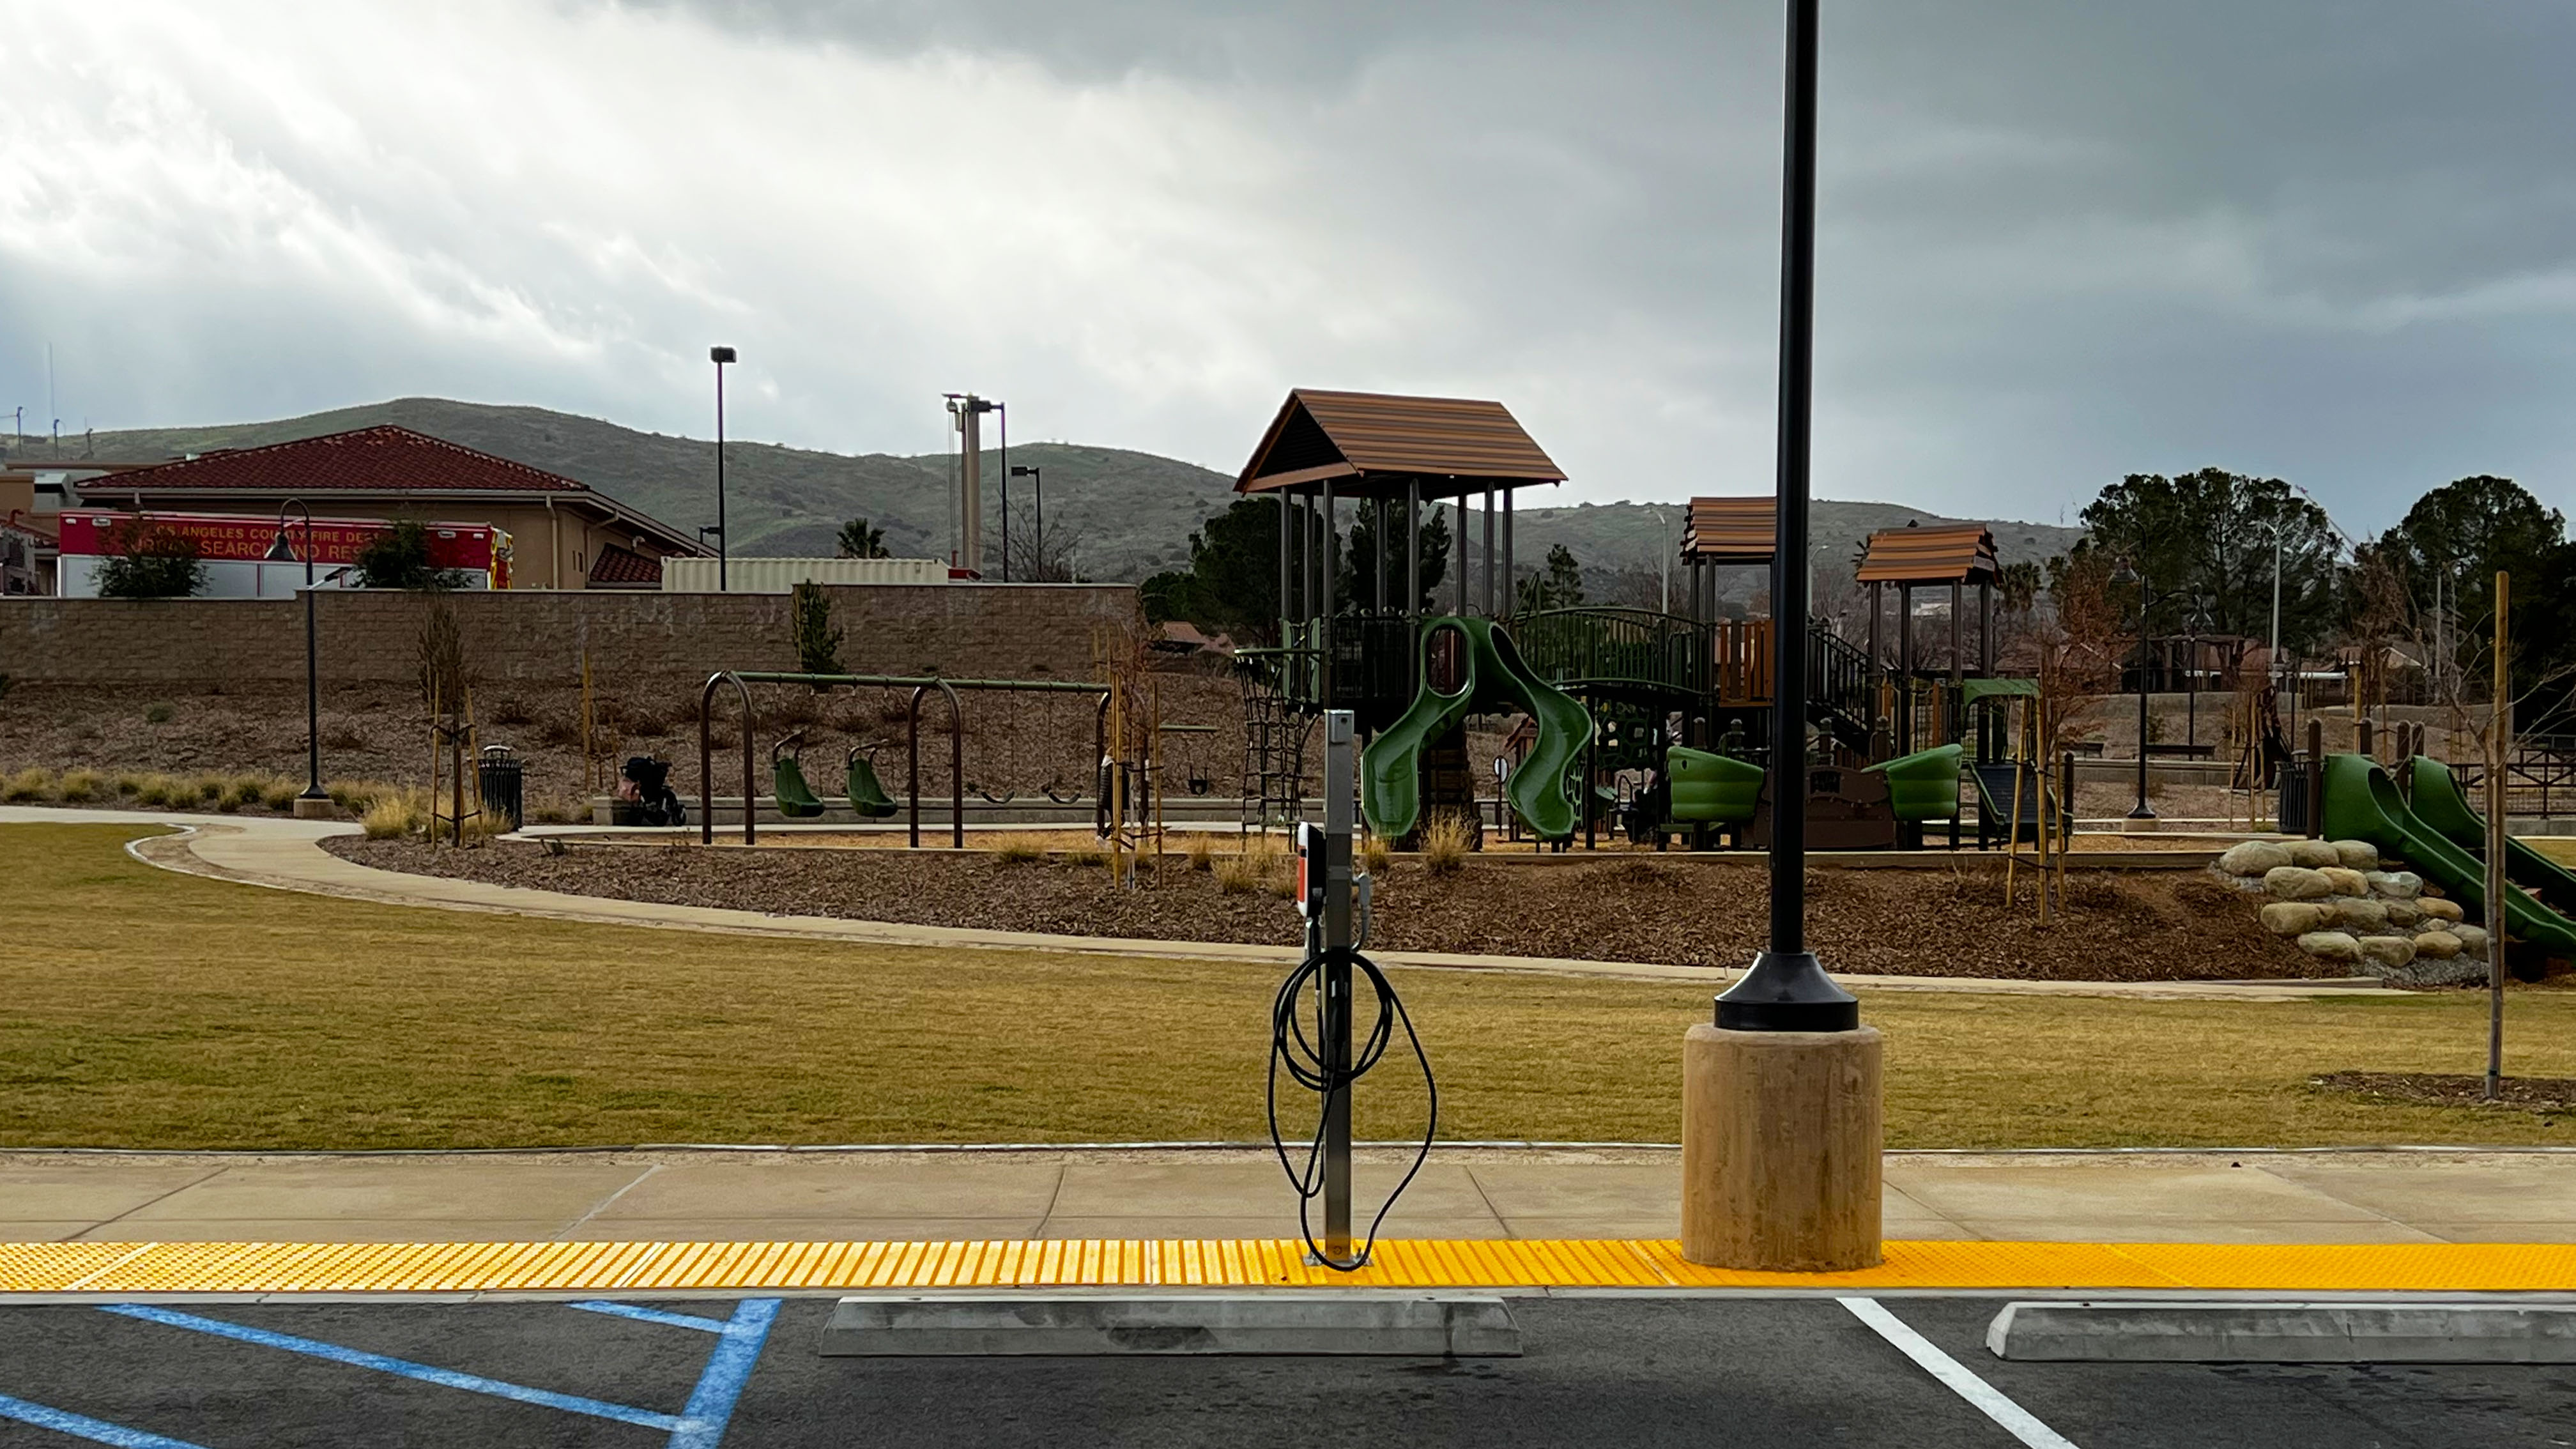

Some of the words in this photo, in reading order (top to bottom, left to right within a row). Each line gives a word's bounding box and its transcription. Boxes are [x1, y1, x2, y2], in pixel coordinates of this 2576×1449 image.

[181, 526, 244, 539] ANGELES
[249, 528, 307, 540] COUTY
[311, 531, 341, 542] FIRE
